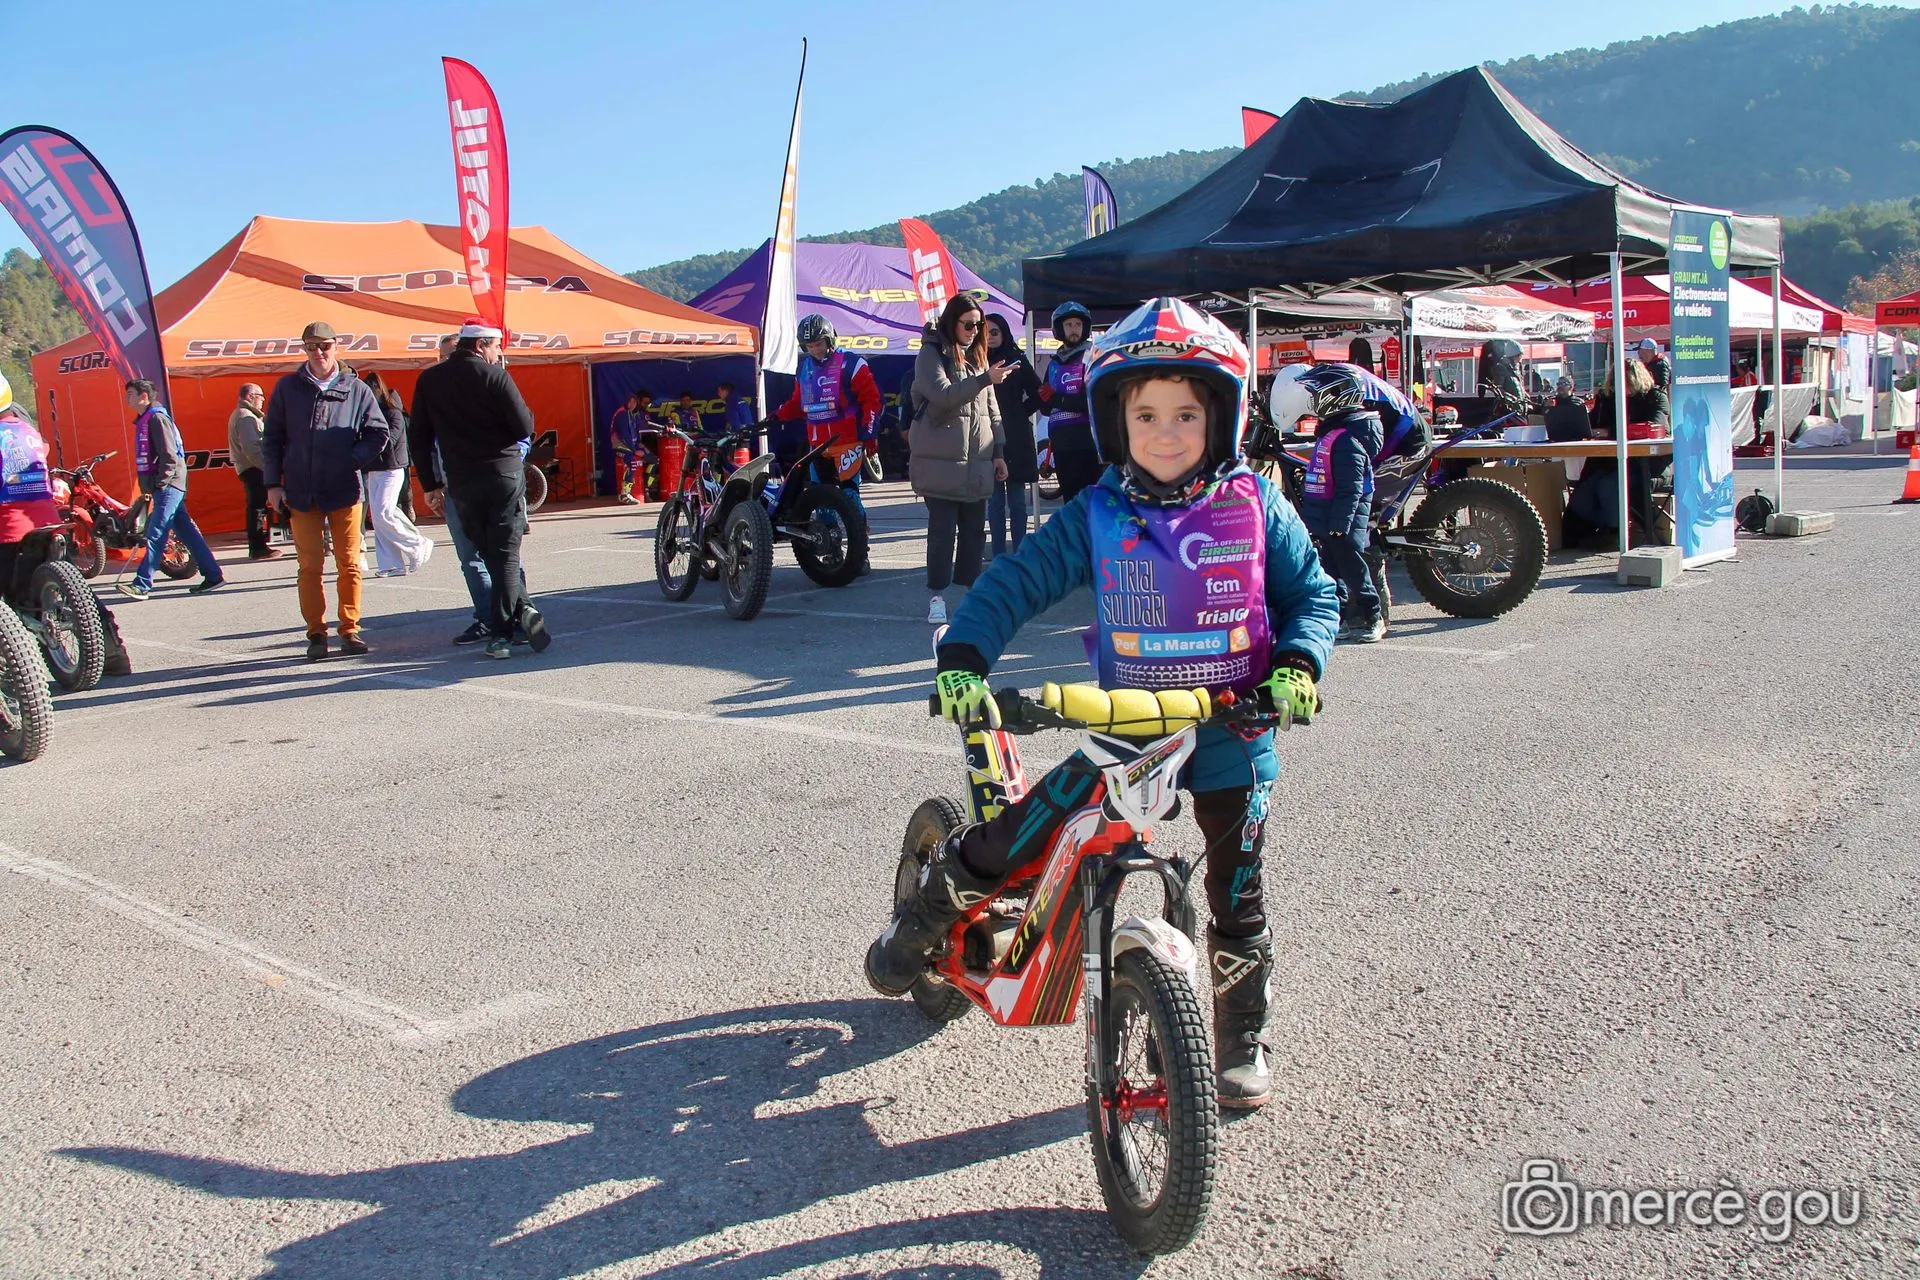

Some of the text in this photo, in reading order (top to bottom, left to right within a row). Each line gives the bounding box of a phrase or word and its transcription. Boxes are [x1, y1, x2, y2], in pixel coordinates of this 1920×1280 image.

[1674, 302, 1685, 316] de
[603, 329, 739, 347] SCORPA
[1220, 538, 1253, 546] OFF-ROAD
[1199, 544, 1252, 556] CIRCUIT
[1206, 578, 1240, 594] fcm
[1114, 638, 1137, 650] Per
[1144, 639, 1161, 651] La
[1164, 635, 1222, 650] Marató
